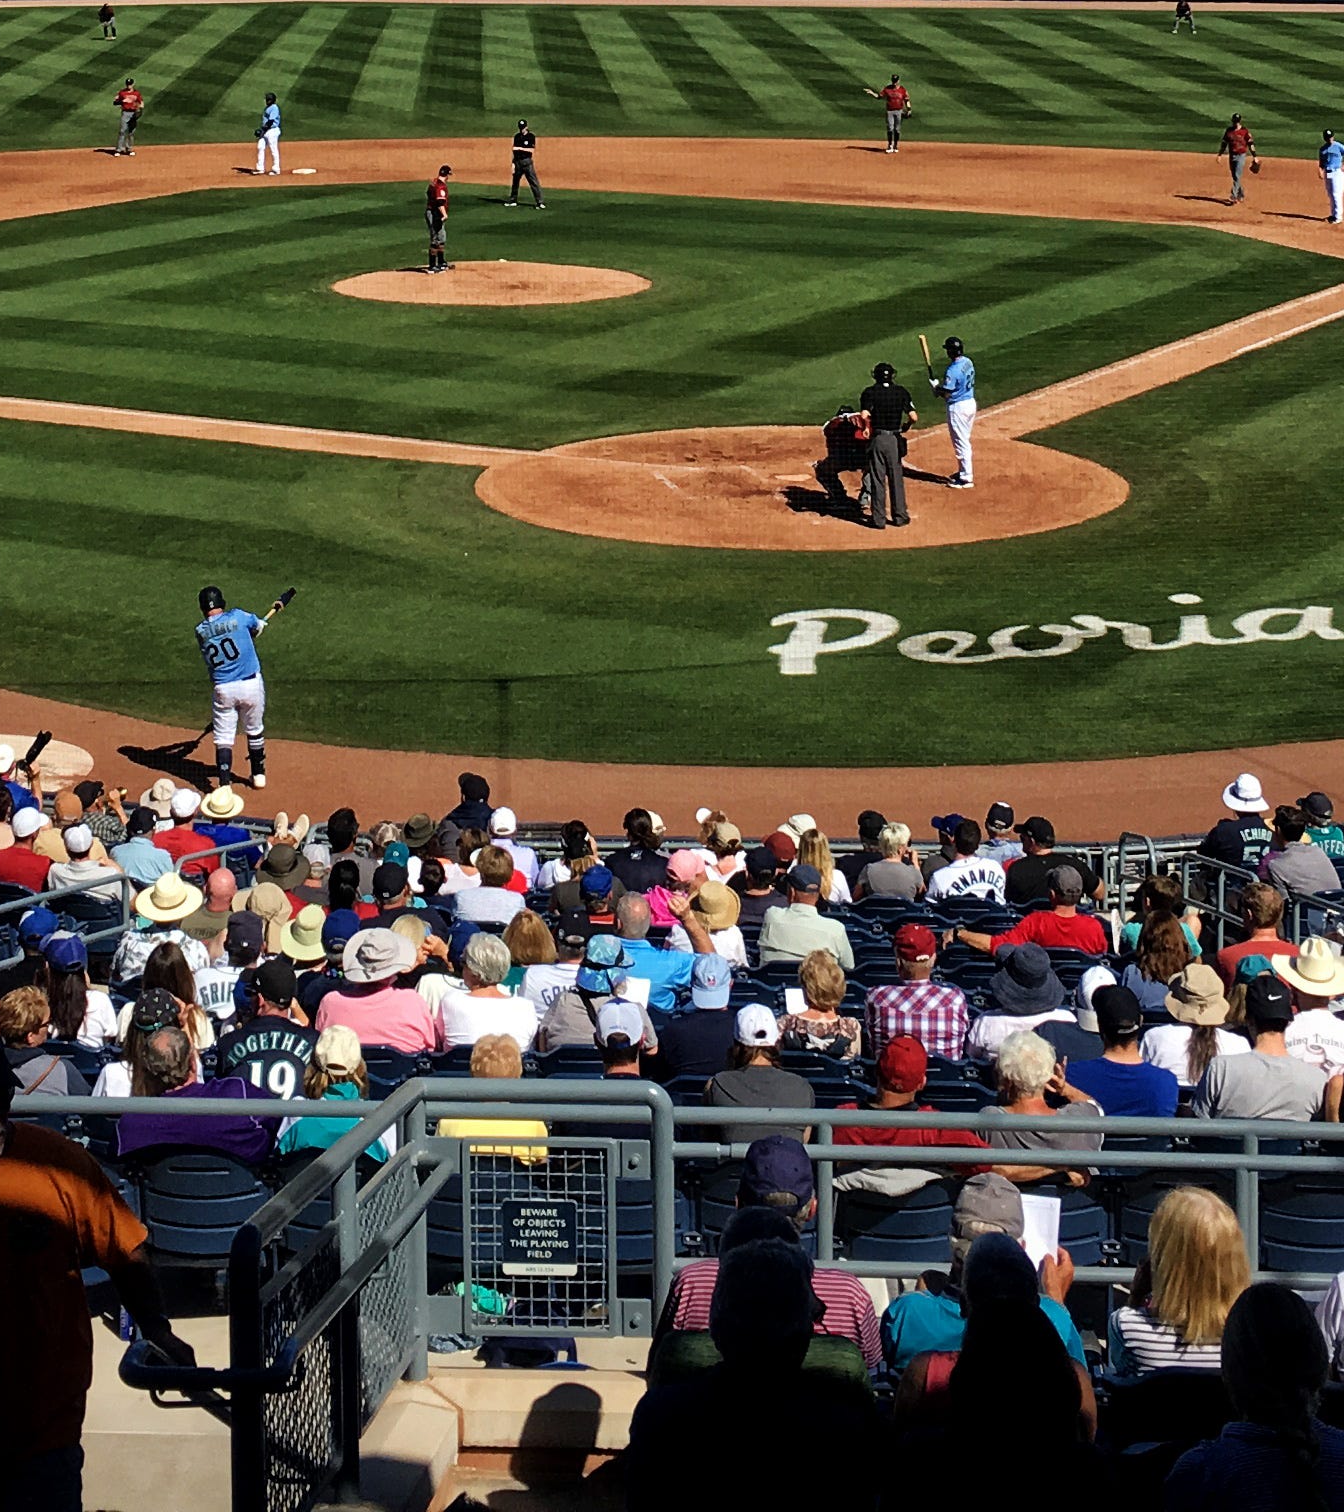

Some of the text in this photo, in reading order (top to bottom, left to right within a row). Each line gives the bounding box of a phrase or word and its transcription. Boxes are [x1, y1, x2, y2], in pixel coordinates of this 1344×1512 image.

[206, 637, 241, 669] 20
[951, 869, 1005, 894] RNANDEZ
[199, 981, 236, 1009] GRIF
[247, 1059, 297, 1100] 19
[520, 1208, 558, 1217] BEWARE
[512, 1218, 567, 1228] OF OBJECTS
[519, 1229, 559, 1238] LEAVING
[509, 1239, 570, 1249] THE PLAYING
[527, 1250, 553, 1259] FIELD
